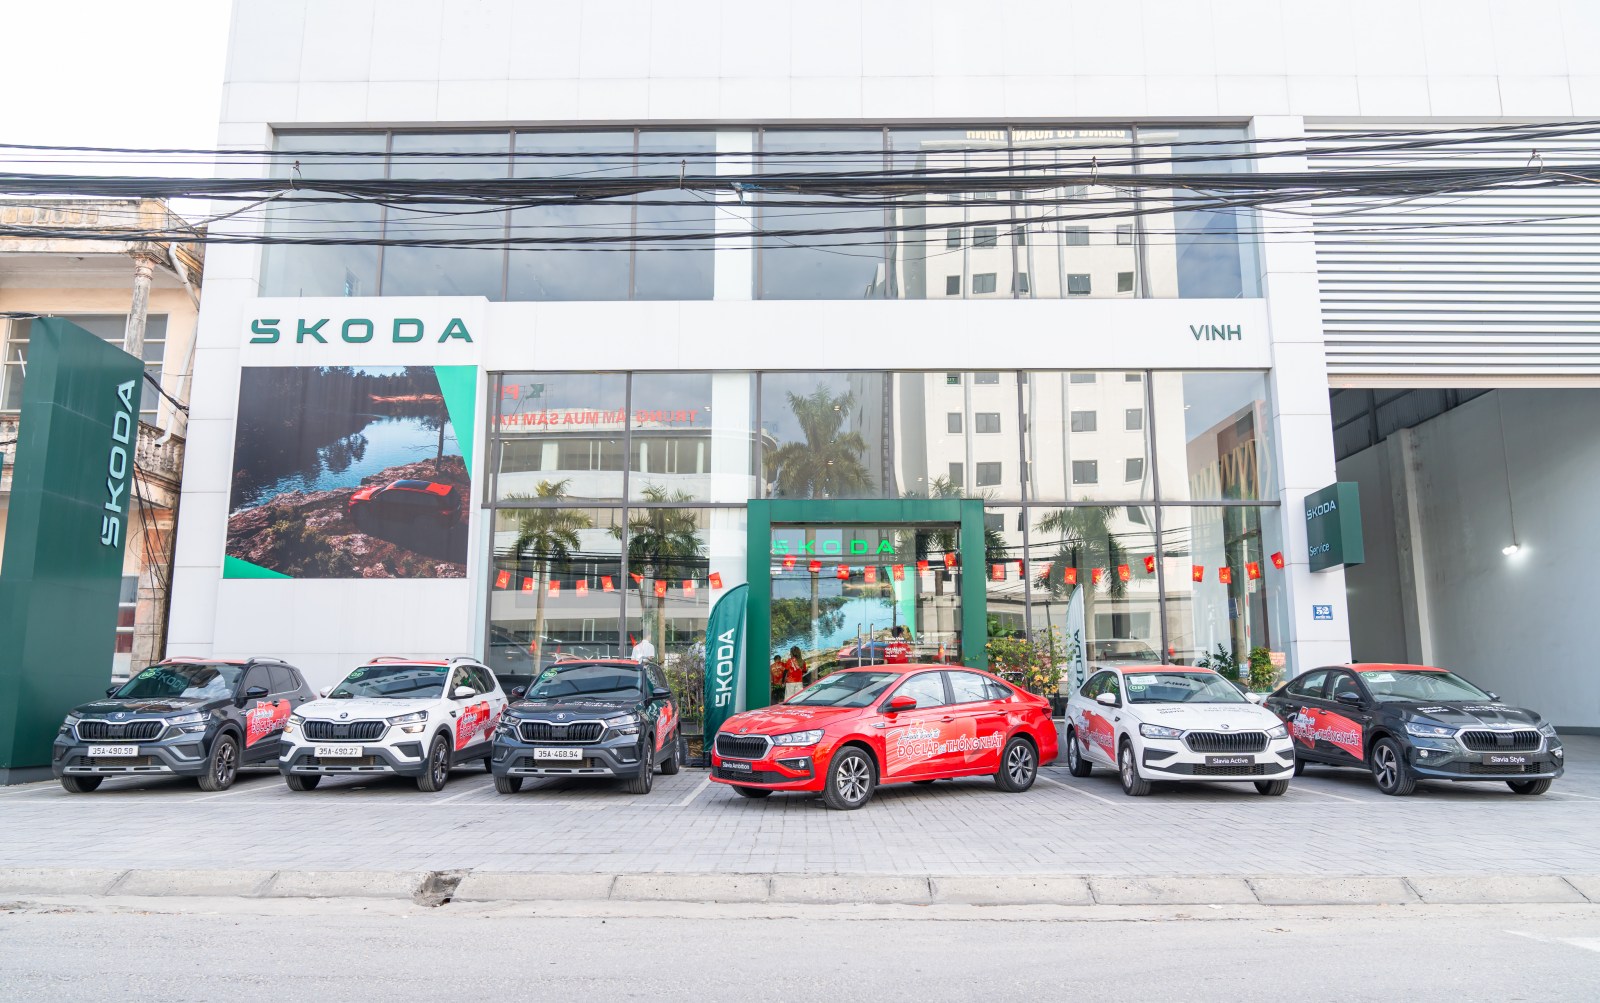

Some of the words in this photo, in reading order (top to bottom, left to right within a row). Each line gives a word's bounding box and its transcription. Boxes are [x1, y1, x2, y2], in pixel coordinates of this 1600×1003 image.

[249, 318, 474, 344] SKODA
[1189, 324, 1242, 341] VINH
[101, 379, 136, 549] SKODA
[1306, 500, 1337, 521] SKODA
[770, 539, 896, 555] SKODA
[1309, 542, 1331, 557] Service
[715, 627, 736, 708] SKODA
[1073, 628, 1085, 689] KODA
[897, 742, 921, 760] ĐỘC
[921, 740, 939, 757] LẬP
[946, 734, 979, 753] THỐNG
[979, 730, 1004, 749] NHẤT
[1490, 755, 1509, 763] Slavia
[1509, 755, 1526, 764] Style
